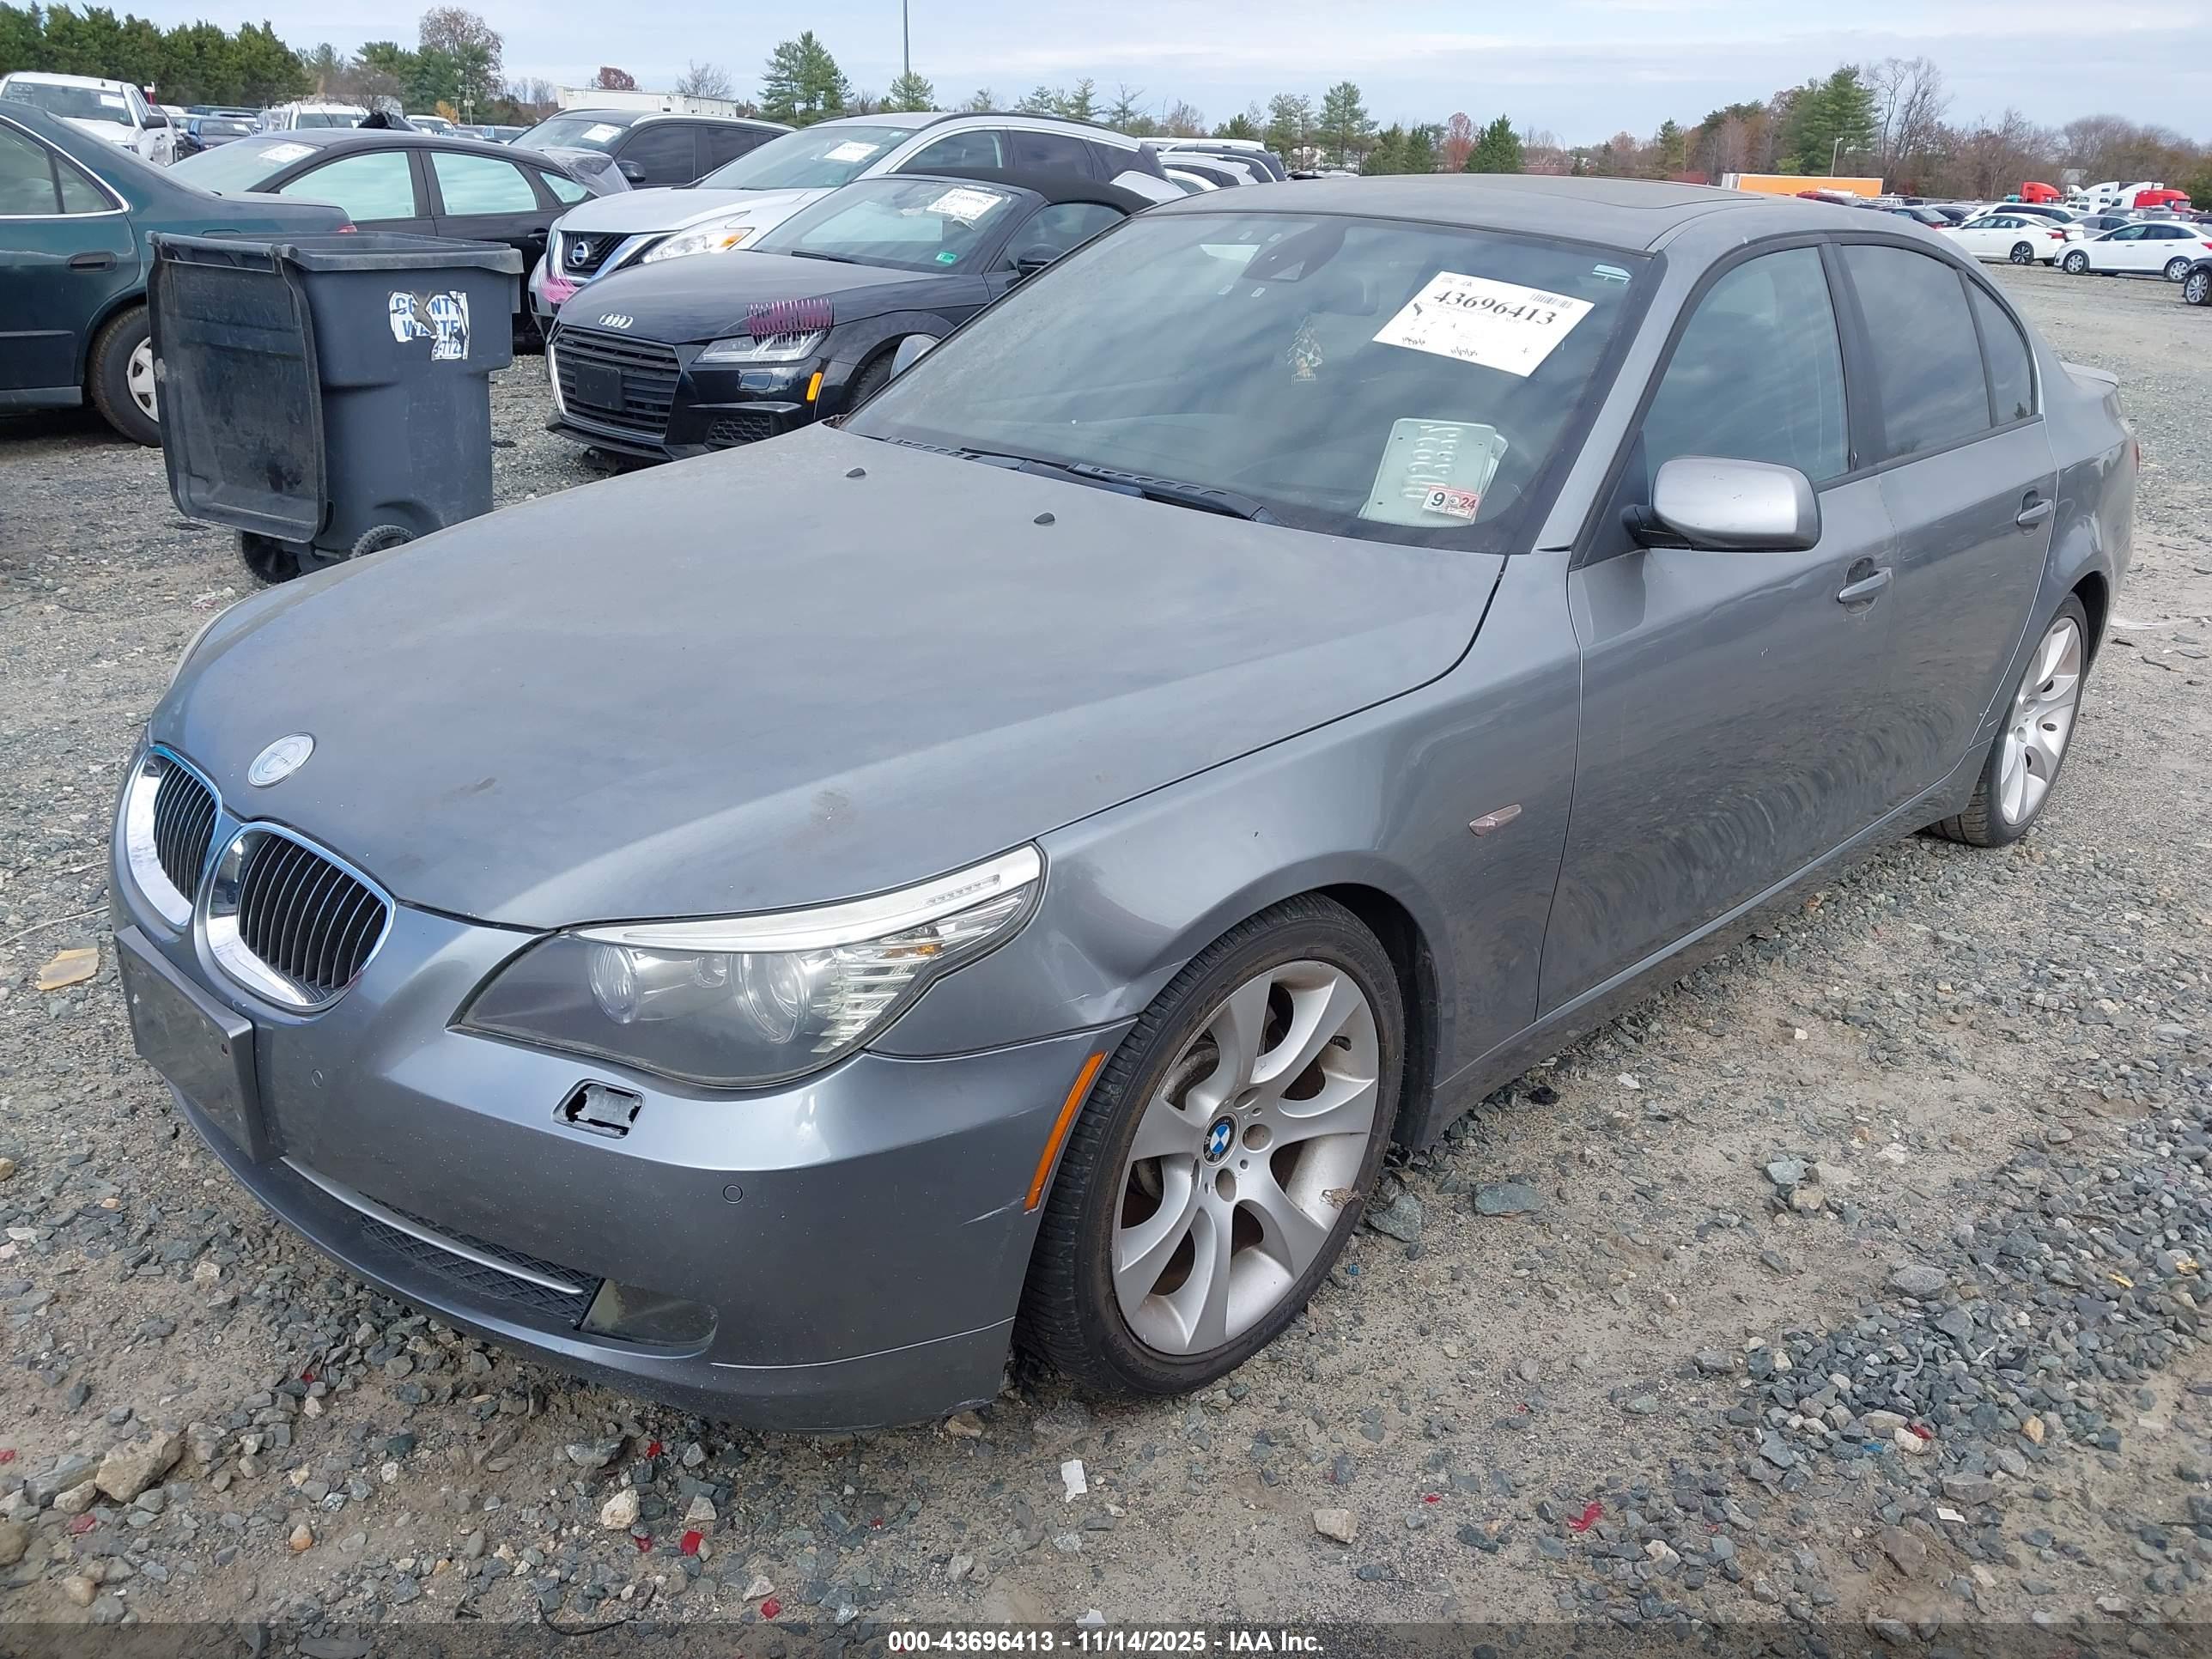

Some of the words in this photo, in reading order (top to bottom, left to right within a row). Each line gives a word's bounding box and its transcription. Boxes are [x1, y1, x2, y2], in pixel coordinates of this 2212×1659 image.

[1432, 289, 1558, 325] 43696413
[1431, 491, 1446, 507] 9
[1460, 496, 1477, 510] 24
